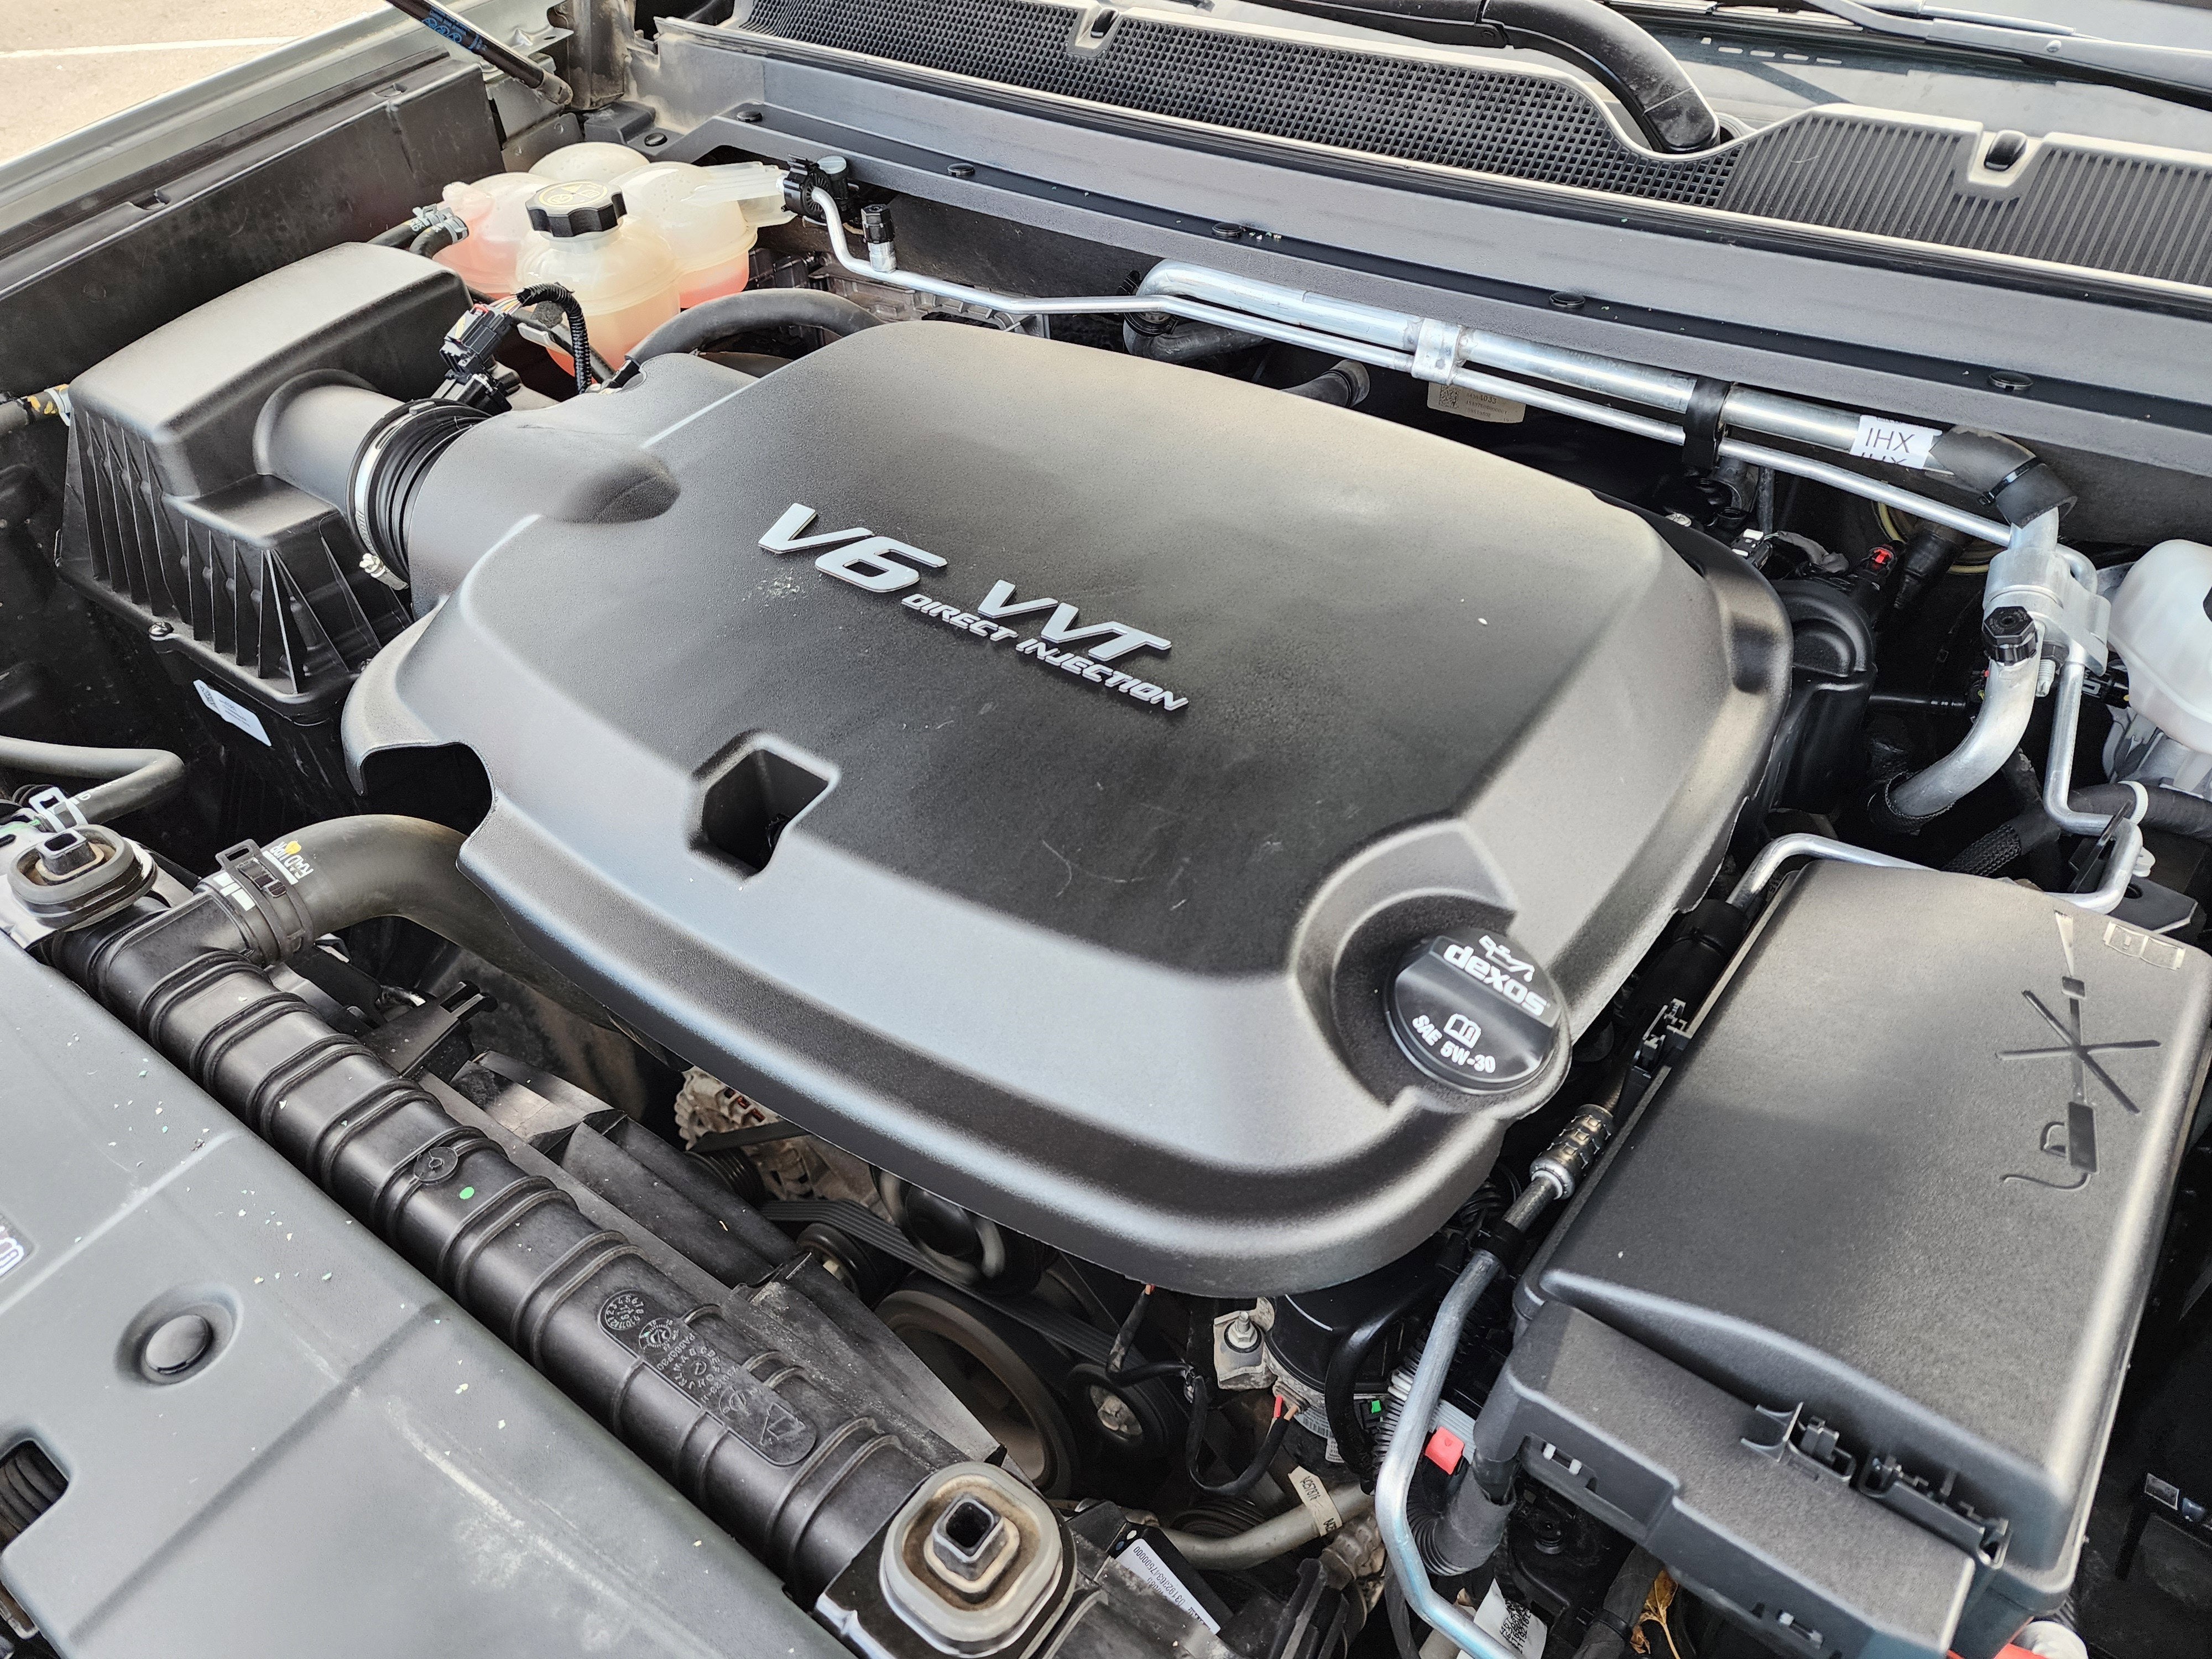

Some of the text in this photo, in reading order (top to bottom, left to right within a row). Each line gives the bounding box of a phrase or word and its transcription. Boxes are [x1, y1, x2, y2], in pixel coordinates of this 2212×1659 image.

[1865, 427, 1915, 453] IHX
[758, 503, 1172, 662] V6 VVT
[901, 593, 1188, 711] DIRECT INJECTION
[284, 855, 314, 880] RAD
[1443, 944, 1548, 1016] dexos
[1412, 1015, 1496, 1073] SAE 5W-30
